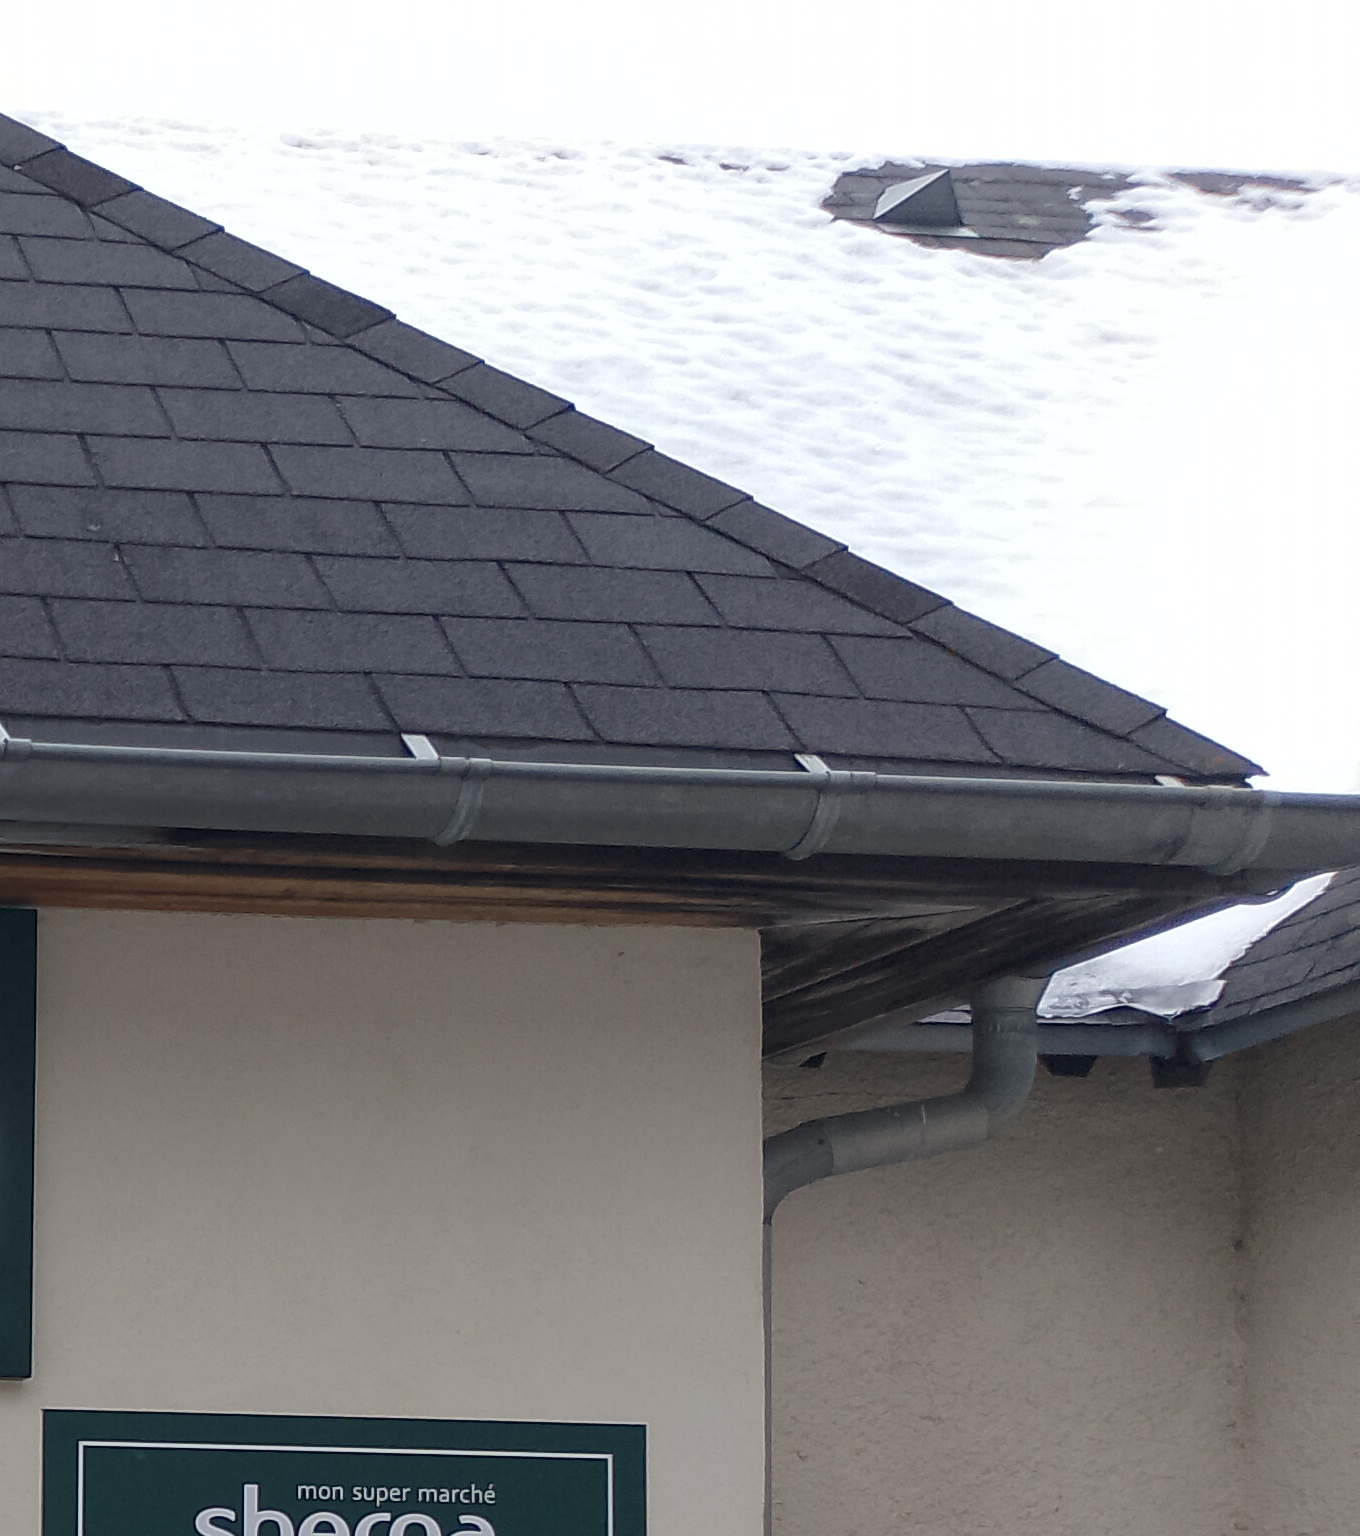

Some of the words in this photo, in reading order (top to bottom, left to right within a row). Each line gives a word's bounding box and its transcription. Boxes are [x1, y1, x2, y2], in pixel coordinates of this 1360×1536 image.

[297, 1484, 344, 1501] mon
[352, 1486, 412, 1508] super
[417, 1483, 496, 1504] marché
